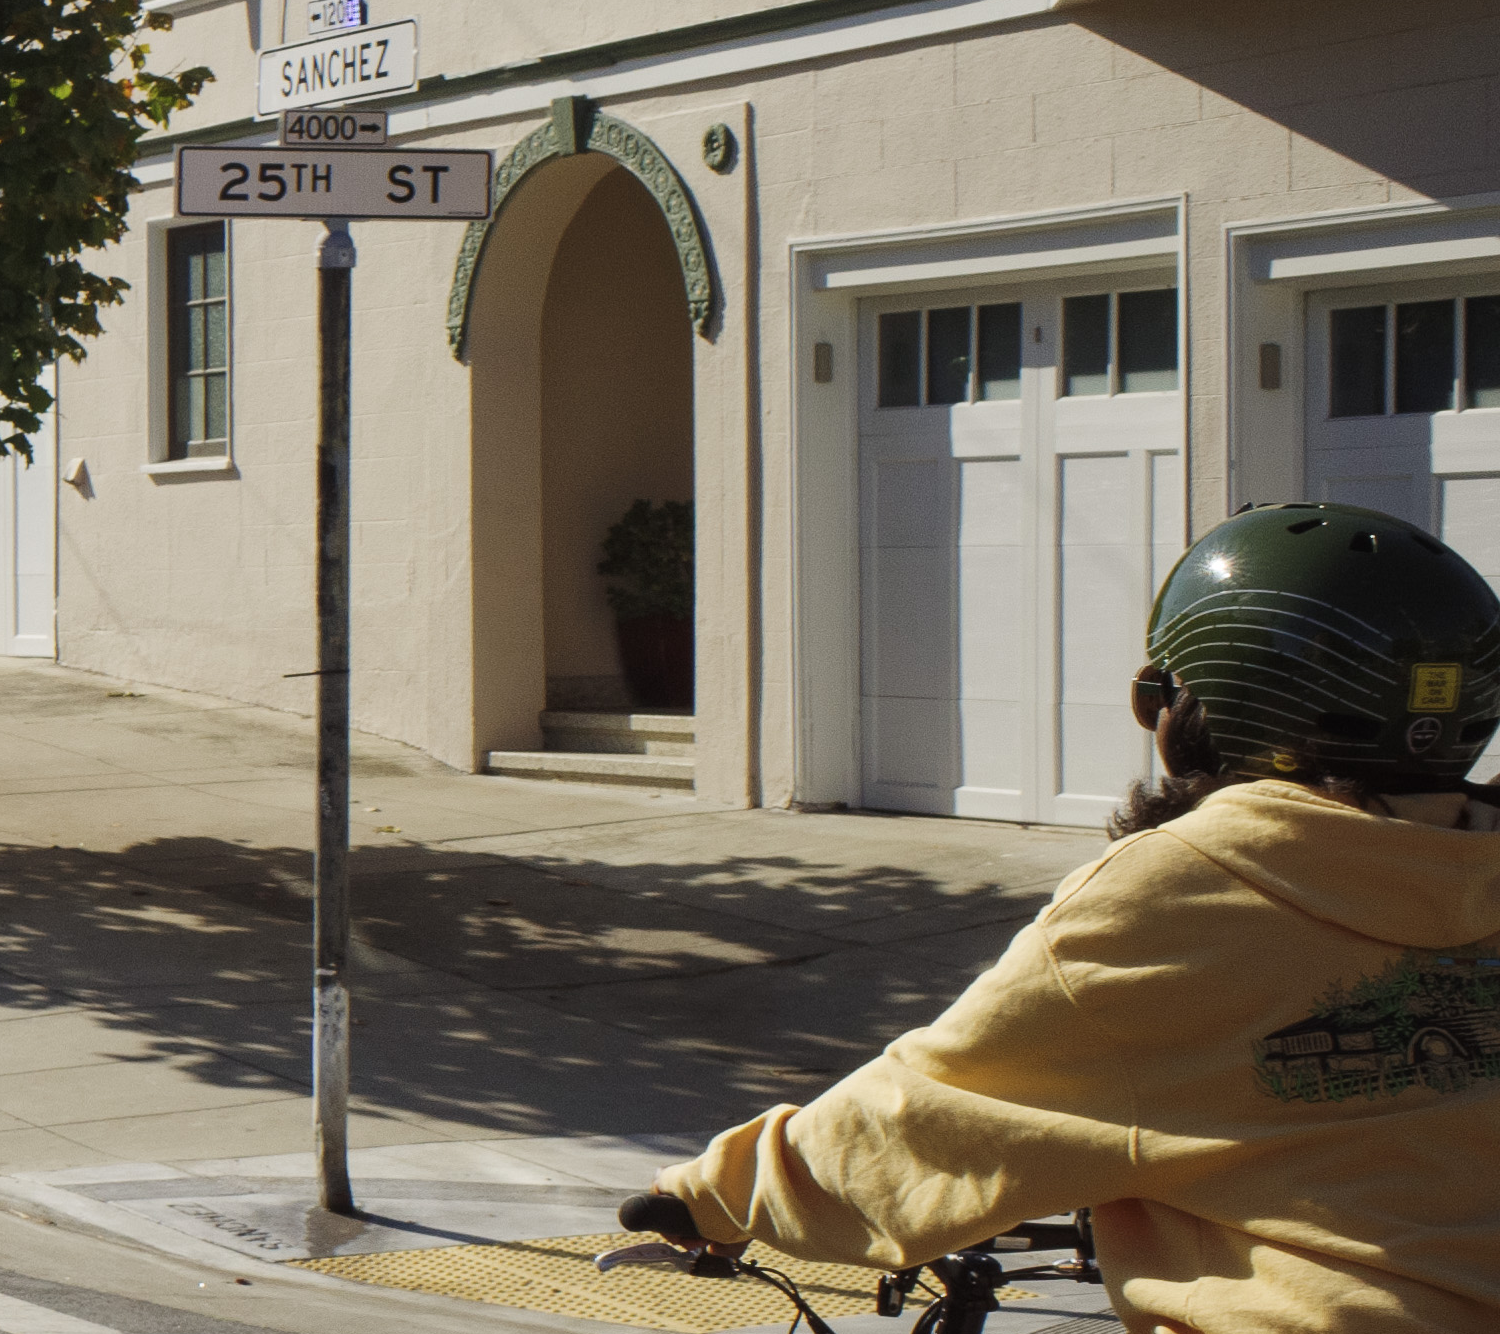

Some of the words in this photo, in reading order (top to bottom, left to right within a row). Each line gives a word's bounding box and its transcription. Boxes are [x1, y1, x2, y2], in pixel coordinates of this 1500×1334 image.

[281, 38, 390, 98] SANCHEZ
[288, 114, 357, 142] 4000
[218, 162, 333, 202] 25TH
[385, 164, 450, 204] ST
[1426, 679, 1447, 687] WAR
[1429, 688, 1442, 696] ON
[1421, 697, 1447, 705] CARS
[166, 1203, 293, 1250] SANCHEZ
